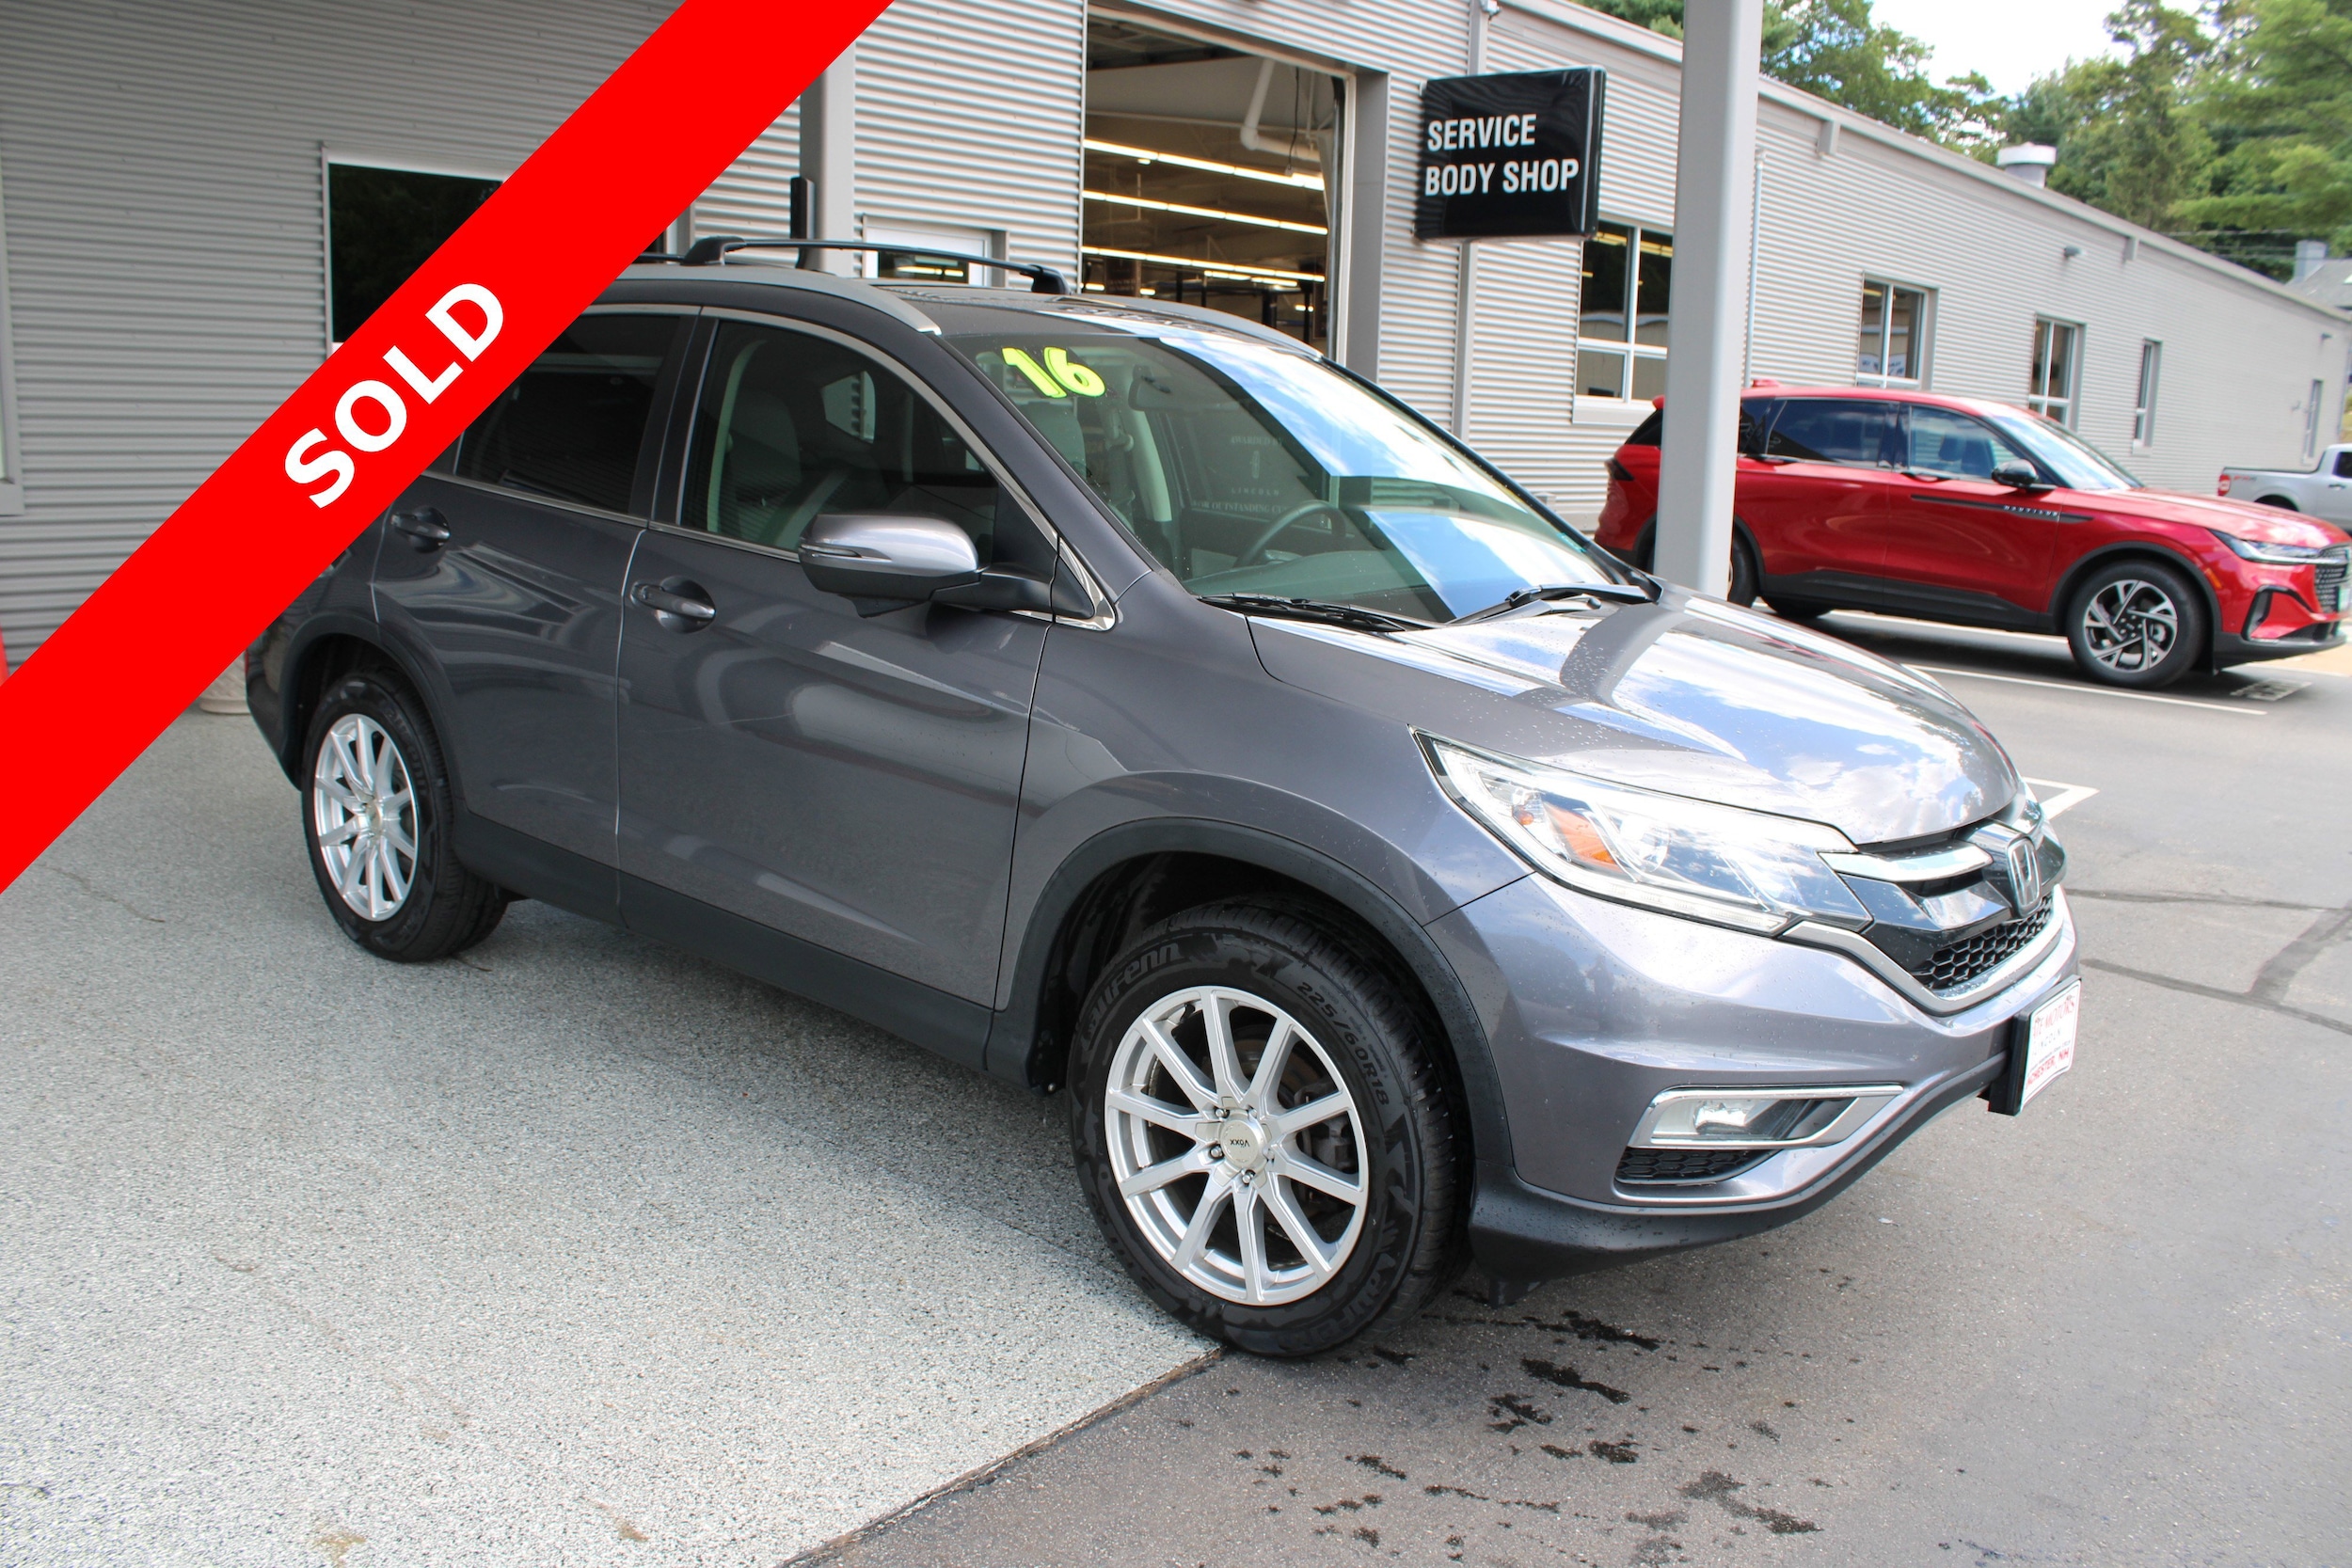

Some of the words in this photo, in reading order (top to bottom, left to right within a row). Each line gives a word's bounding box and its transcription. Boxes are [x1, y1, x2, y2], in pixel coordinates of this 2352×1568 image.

[1427, 114, 1537, 152] SERVICE
[1424, 162, 1496, 197] BODY
[1502, 158, 1580, 194] SHOP
[1002, 346, 1105, 399] 16
[1232, 487, 1280, 496] LINCOLN
[2044, 998, 2075, 1028] MOTORS
[1296, 981, 1390, 1106] 225/60R18
[2058, 1046, 2070, 1061] NH
